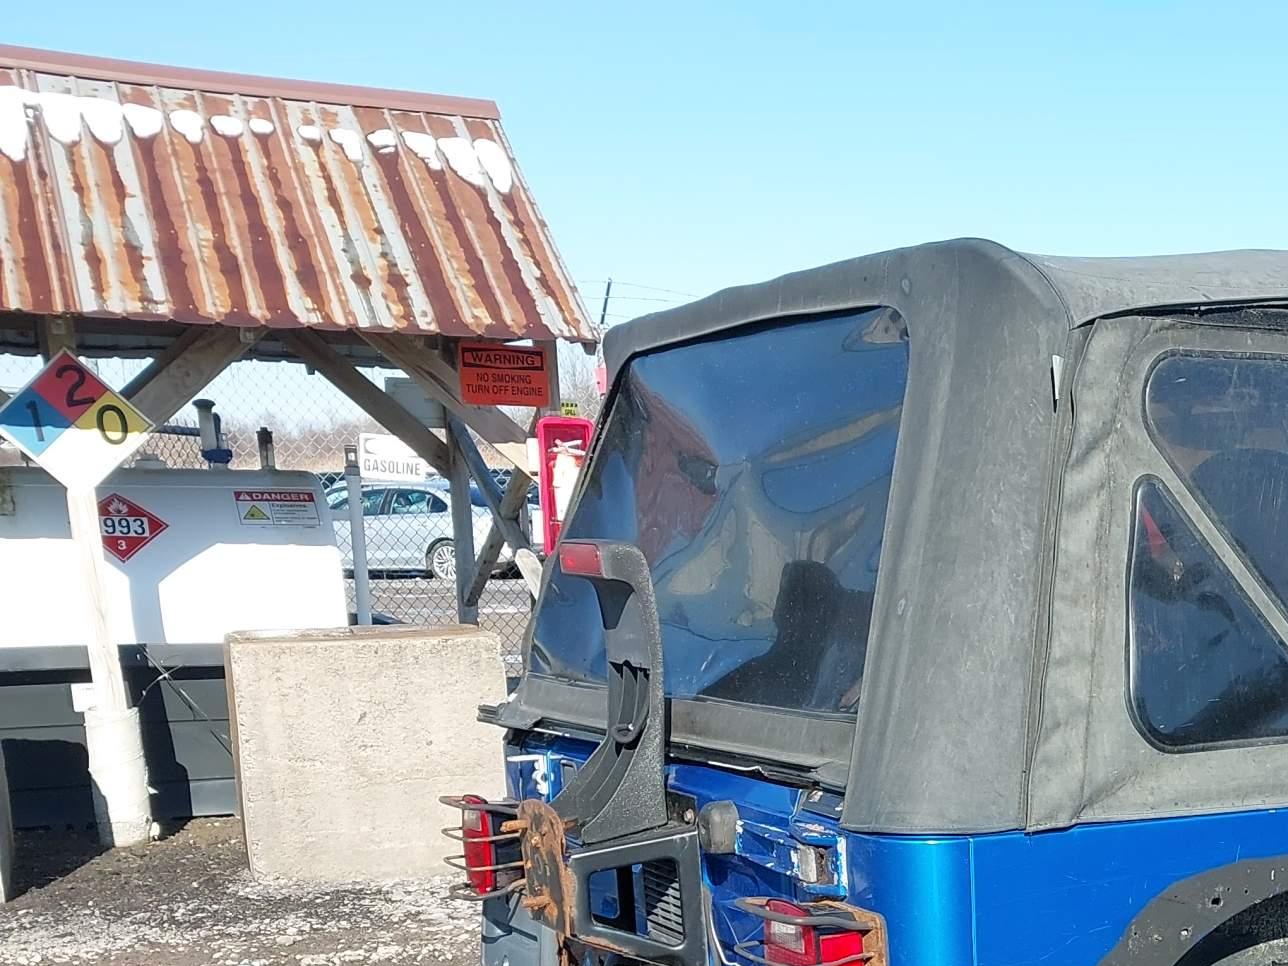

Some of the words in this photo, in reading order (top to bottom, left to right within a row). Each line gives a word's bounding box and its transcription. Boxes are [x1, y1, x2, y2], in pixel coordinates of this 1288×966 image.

[471, 351, 535, 366] WARNING
[56, 364, 97, 408] 2
[476, 372, 489, 383] NO
[491, 373, 532, 385] SMOKING
[466, 383, 490, 394] TURN
[492, 385, 510, 395] OFF
[511, 386, 543, 397] ENGINE
[25, 400, 45, 442] 1
[96, 404, 129, 446] 0
[363, 458, 421, 476] GASOLINE
[252, 492, 310, 501] DANGER
[102, 517, 146, 536] 993
[117, 540, 127, 551] 3
